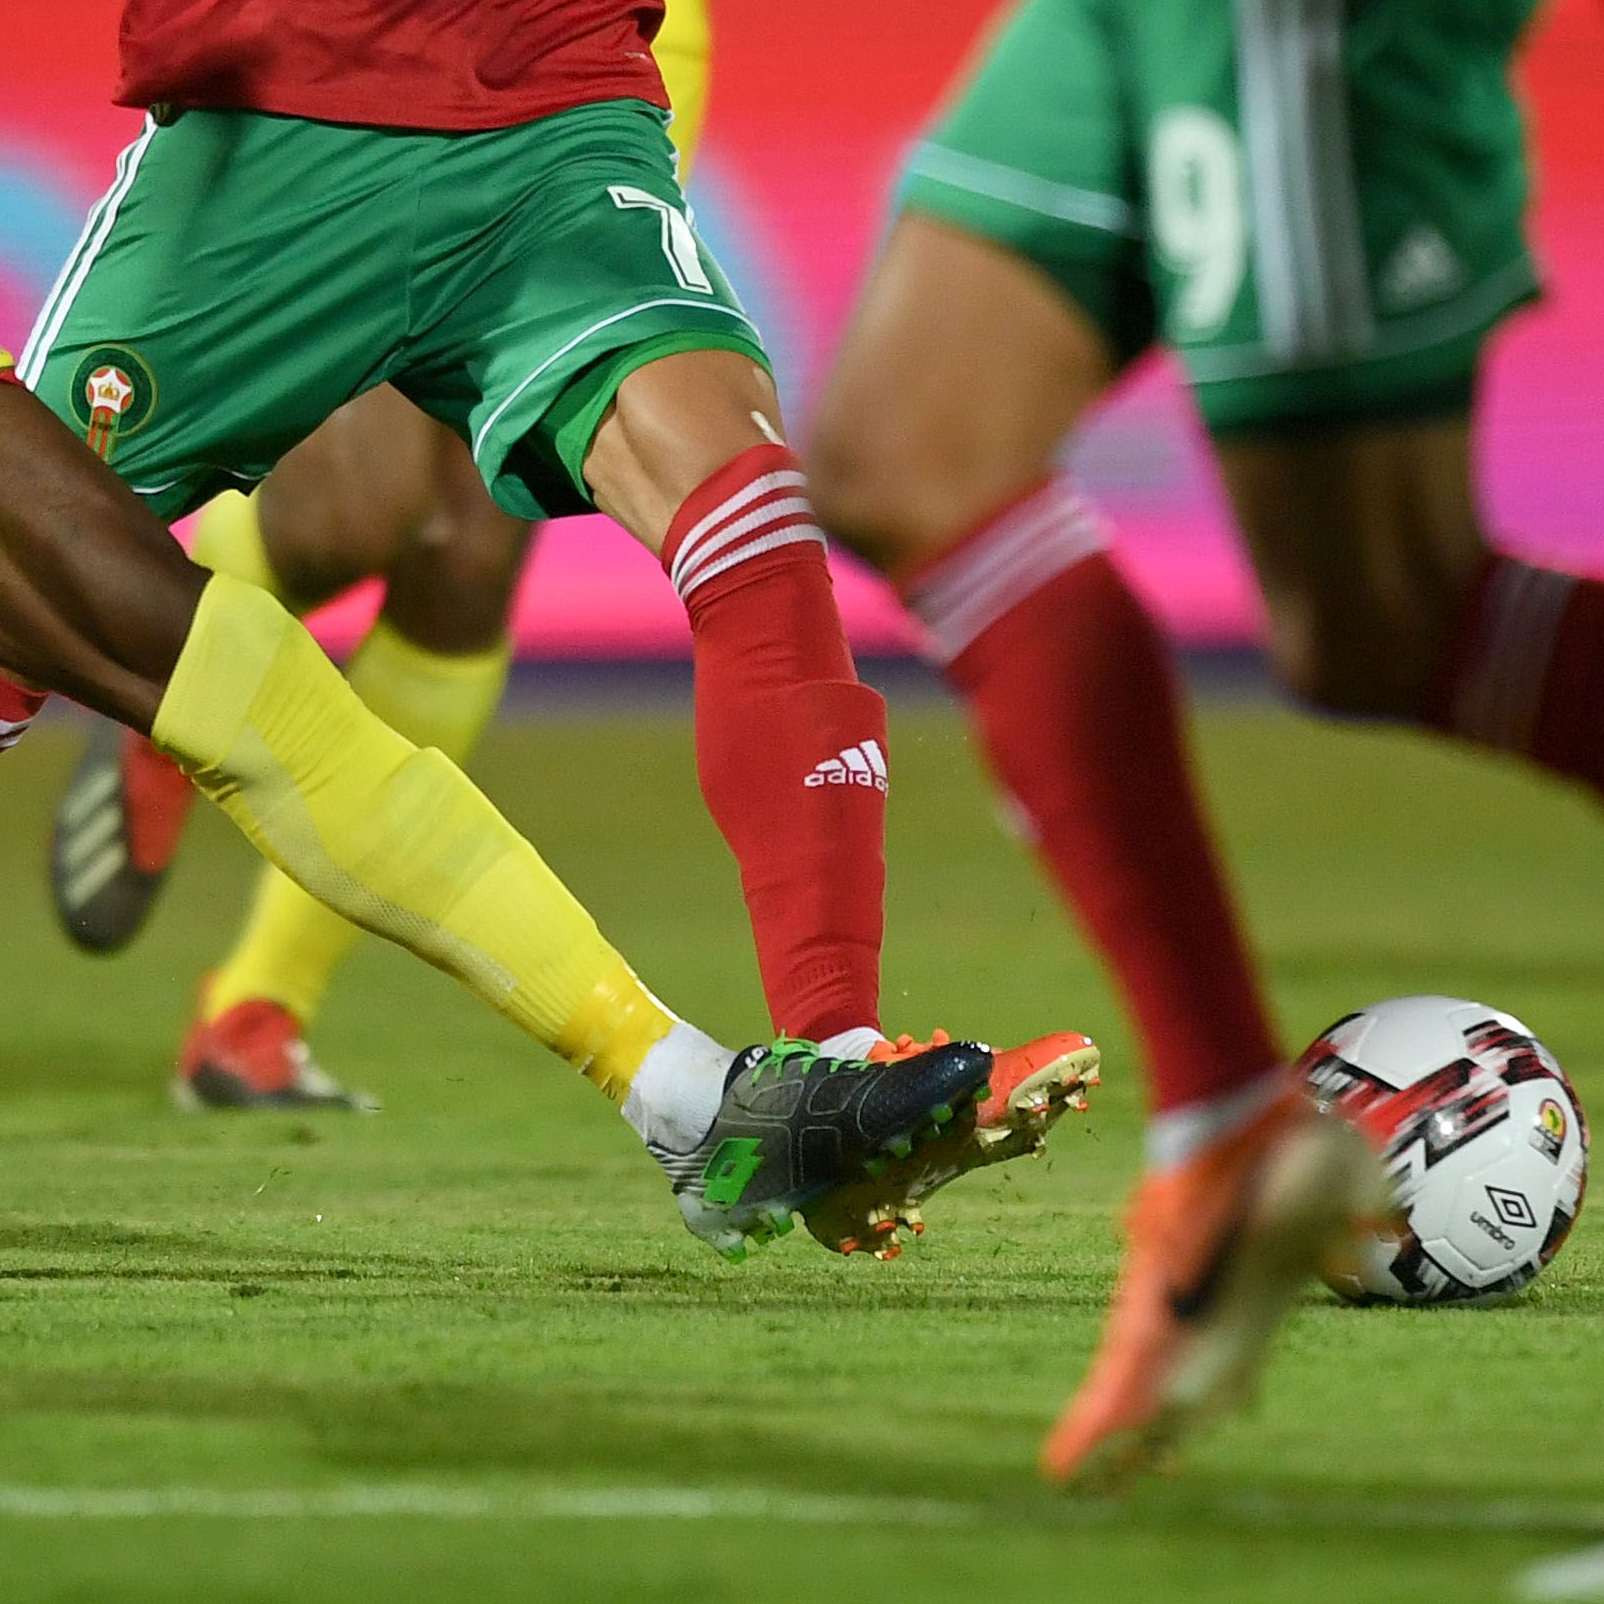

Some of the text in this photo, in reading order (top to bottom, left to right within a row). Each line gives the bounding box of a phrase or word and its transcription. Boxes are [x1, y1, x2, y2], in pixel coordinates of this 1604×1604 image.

[607, 184, 714, 294] 7
[1148, 102, 1246, 342] 9
[804, 767, 890, 796] adida
[1470, 1211, 1516, 1251] umbro
